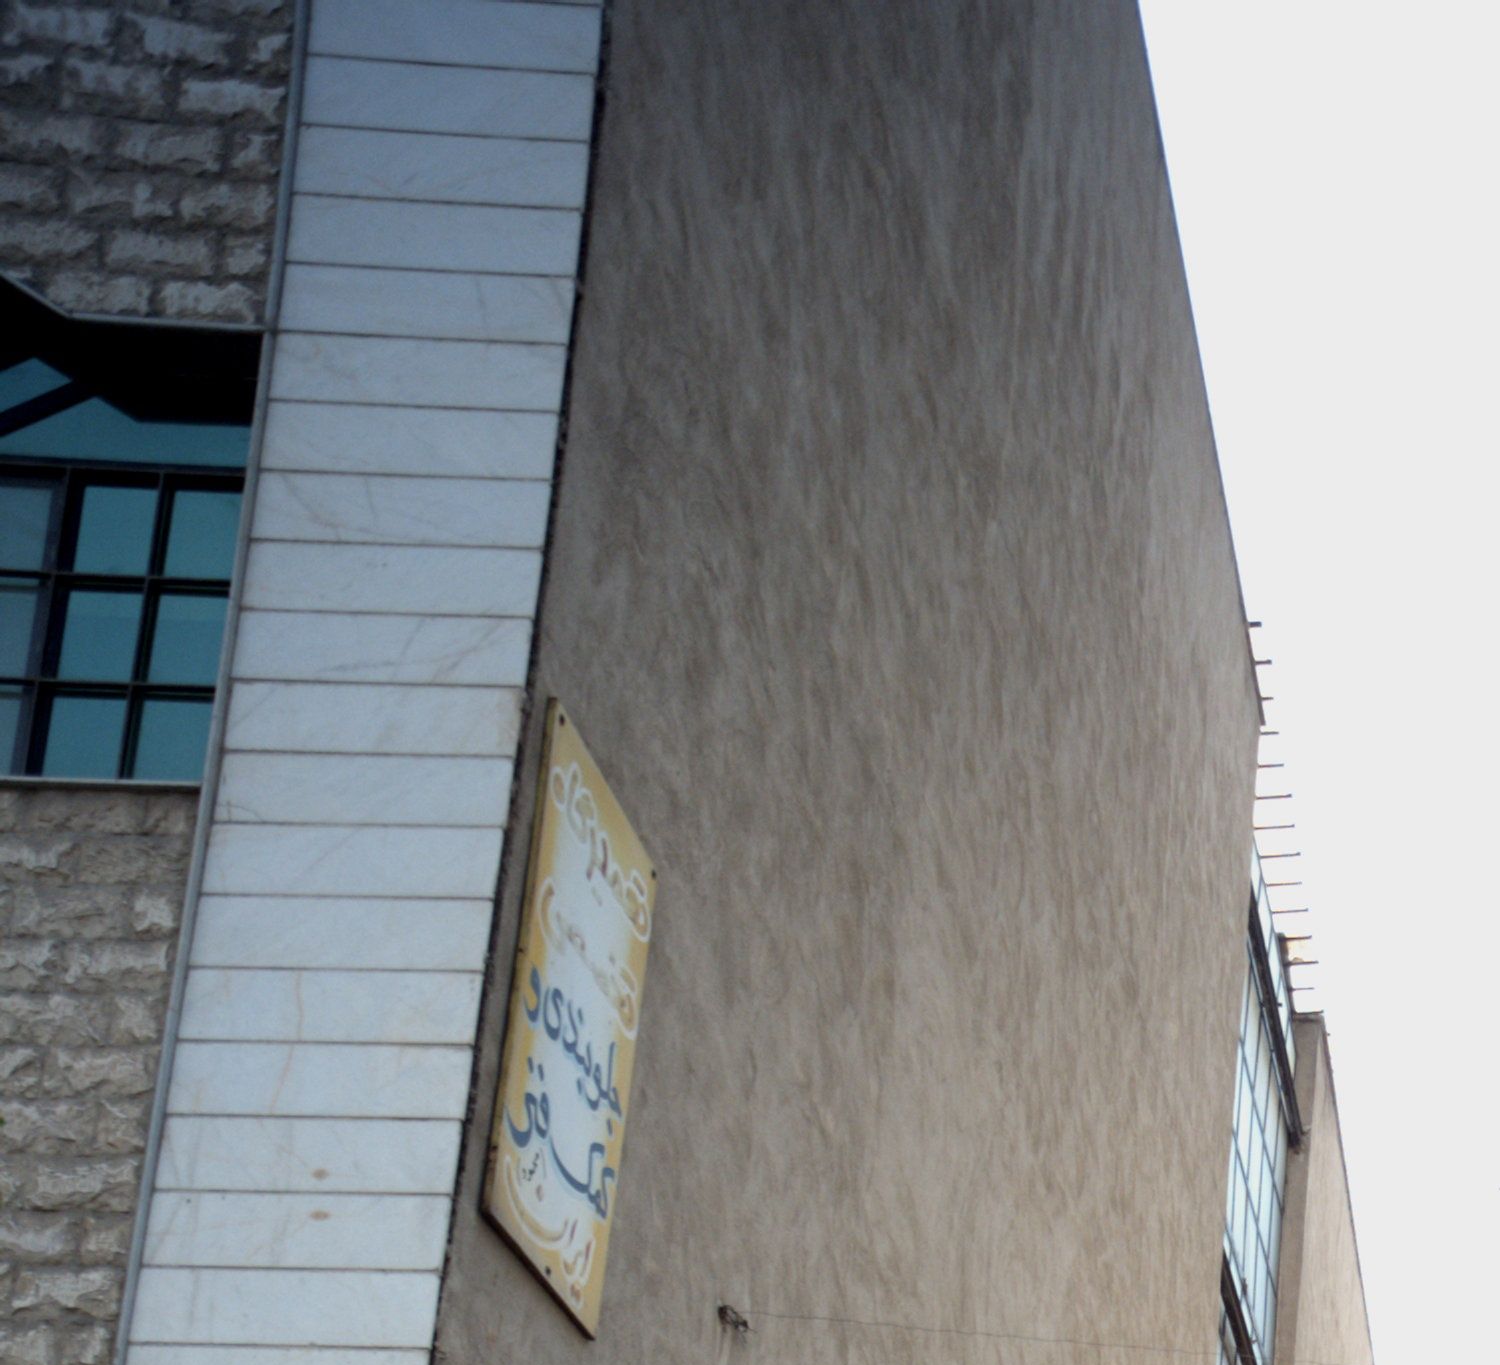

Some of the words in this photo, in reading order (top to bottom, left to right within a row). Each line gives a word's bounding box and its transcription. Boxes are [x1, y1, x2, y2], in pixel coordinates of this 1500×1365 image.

[551, 760, 651, 942] تعمیرگاه
[524, 967, 541, 1023] و
[506, 1056, 549, 1148] فنر
[550, 1142, 615, 1219] کمک
[505, 1154, 594, 1308] ایران
